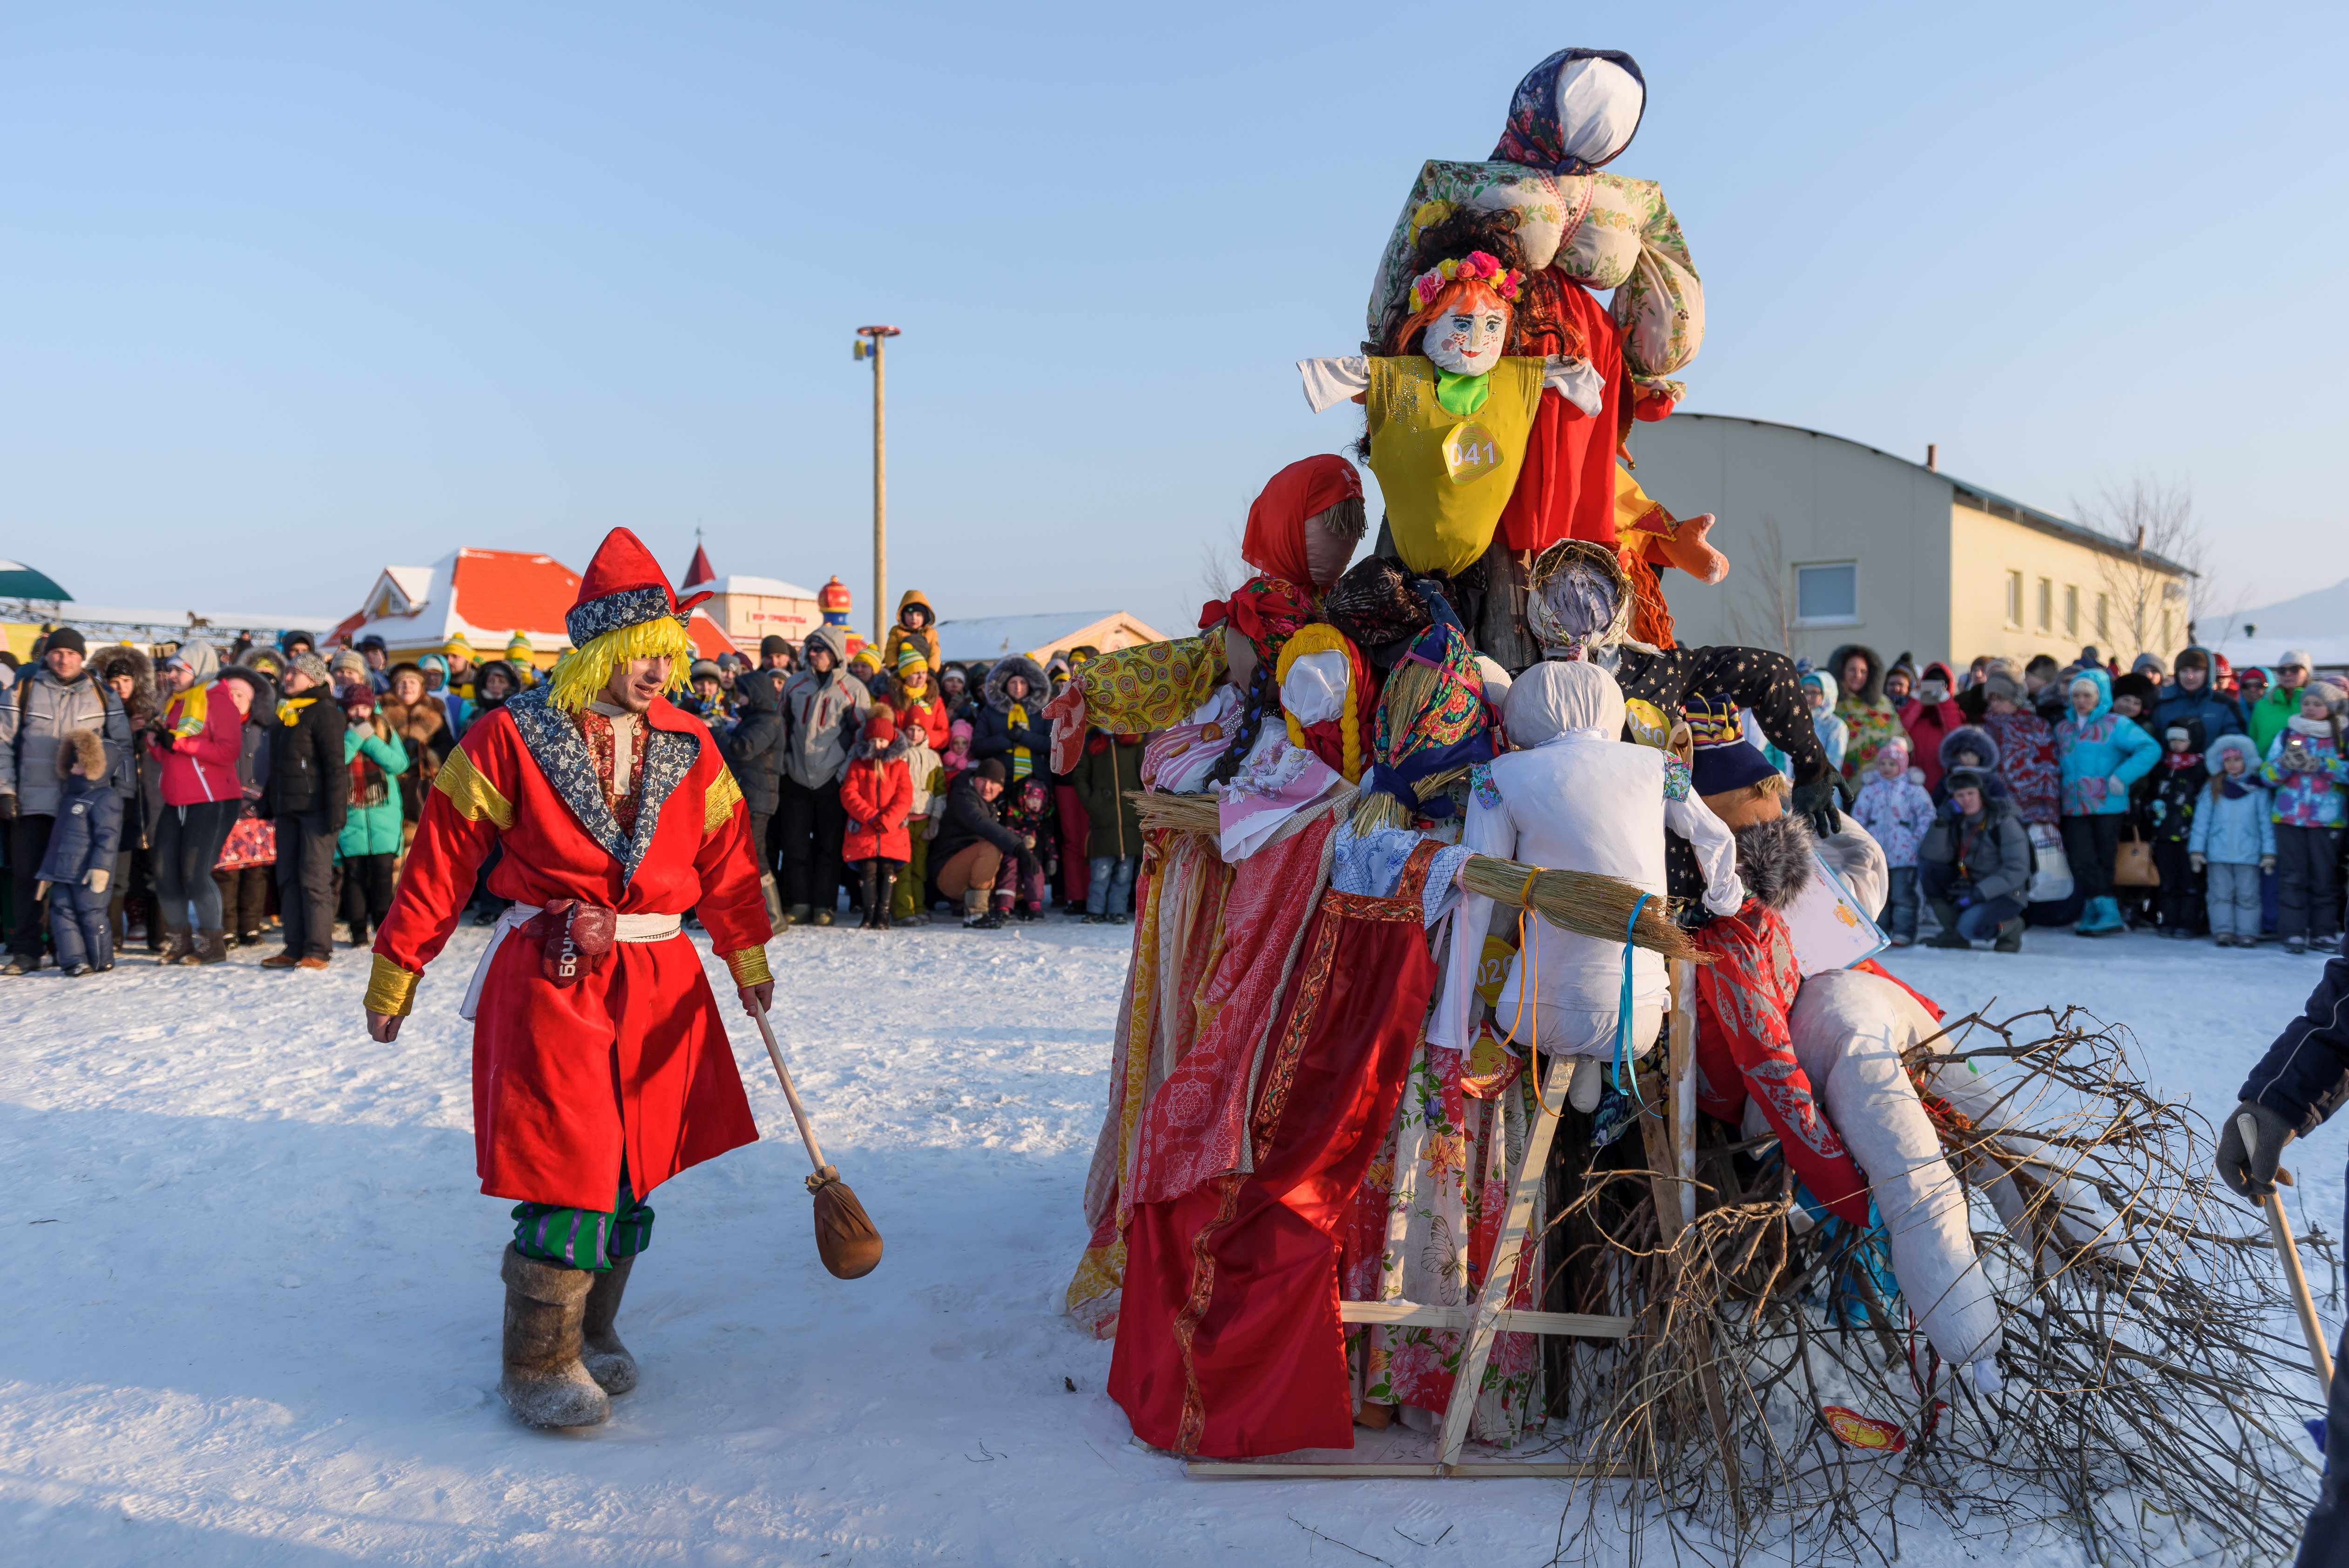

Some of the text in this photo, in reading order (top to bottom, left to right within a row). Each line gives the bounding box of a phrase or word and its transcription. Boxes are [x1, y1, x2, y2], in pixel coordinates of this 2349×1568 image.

[1450, 440, 1494, 466] 041
[1628, 711, 1665, 746] 040
[1460, 1062, 1509, 1081] ажигай!
